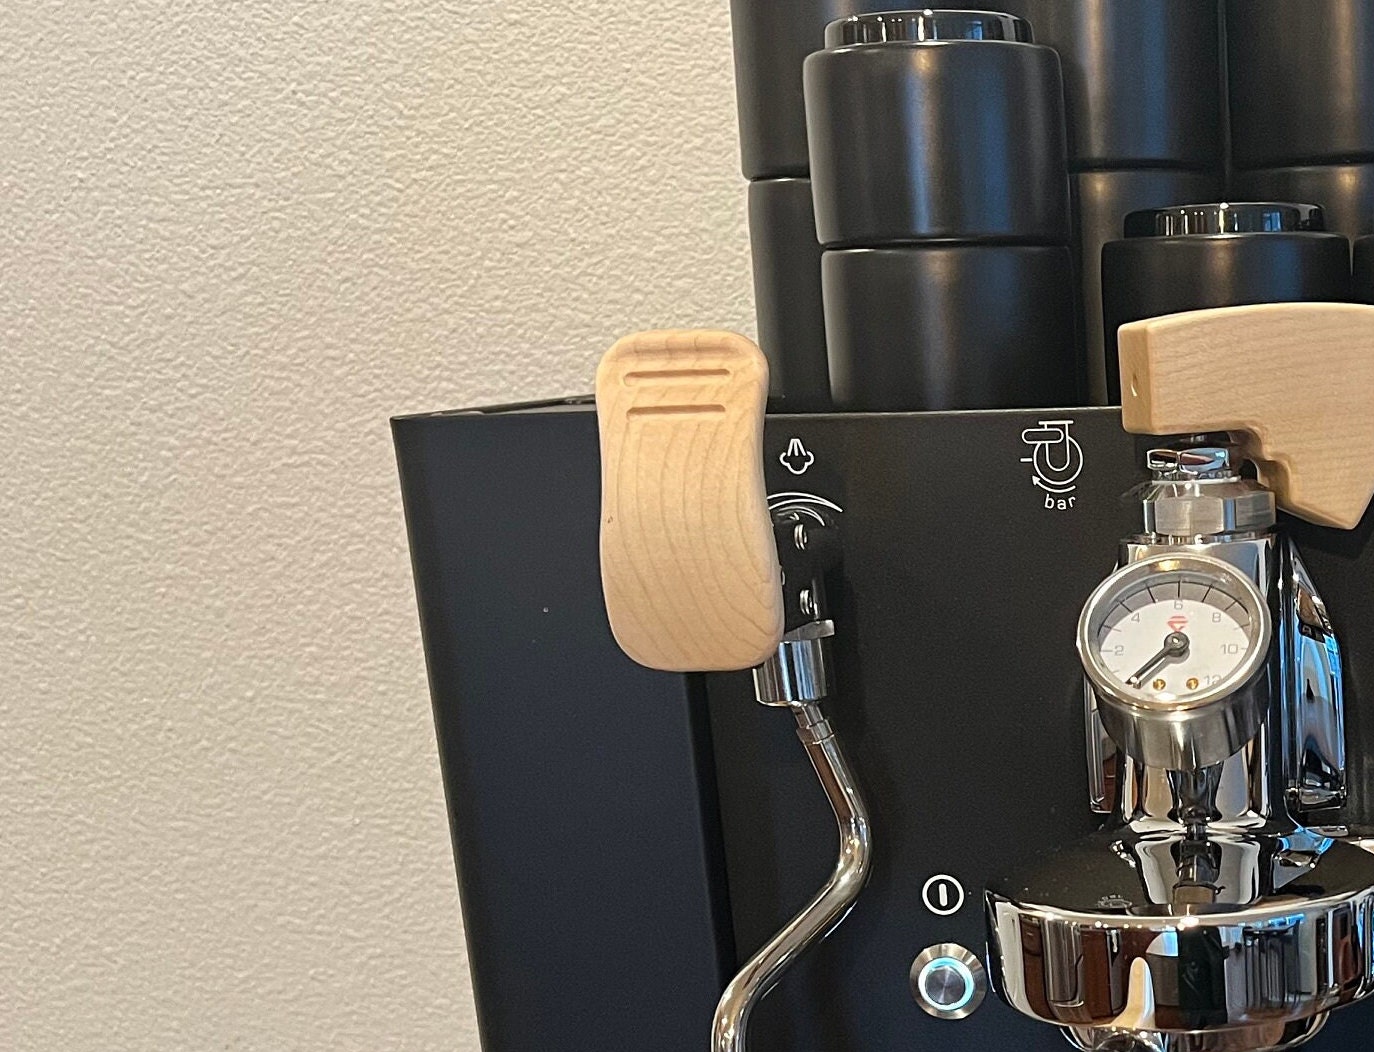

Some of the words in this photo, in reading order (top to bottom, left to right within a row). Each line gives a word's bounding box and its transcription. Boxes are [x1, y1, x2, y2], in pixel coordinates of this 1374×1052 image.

[1044, 493, 1076, 510] bar
[1173, 600, 1183, 611] 6
[1130, 612, 1141, 623] 4
[1211, 612, 1222, 623] 8
[1113, 645, 1125, 656] 2
[1221, 644, 1239, 655] 10
